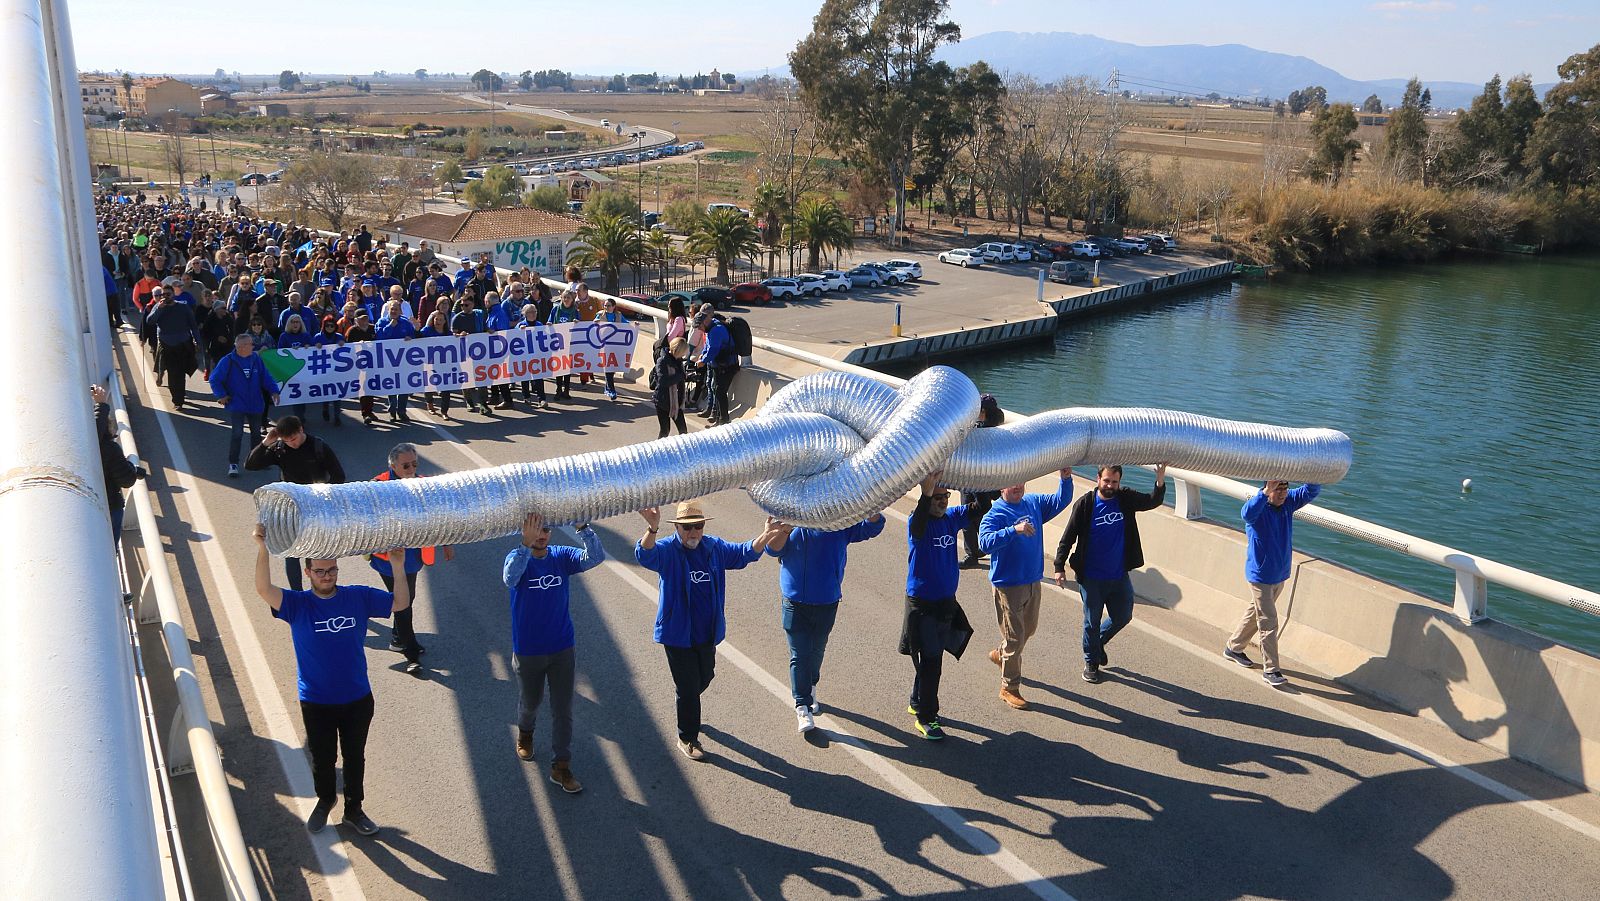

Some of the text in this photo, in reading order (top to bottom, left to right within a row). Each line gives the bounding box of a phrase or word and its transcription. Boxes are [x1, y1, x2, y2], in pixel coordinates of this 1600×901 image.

[307, 329, 565, 375] #SalvemloDelta
[288, 383, 302, 399] 3
[308, 379, 361, 399] anys
[367, 374, 401, 390] del
[407, 367, 469, 388] Glòria
[474, 352, 592, 382] SOLUCIONS,
[597, 352, 619, 368] JA
